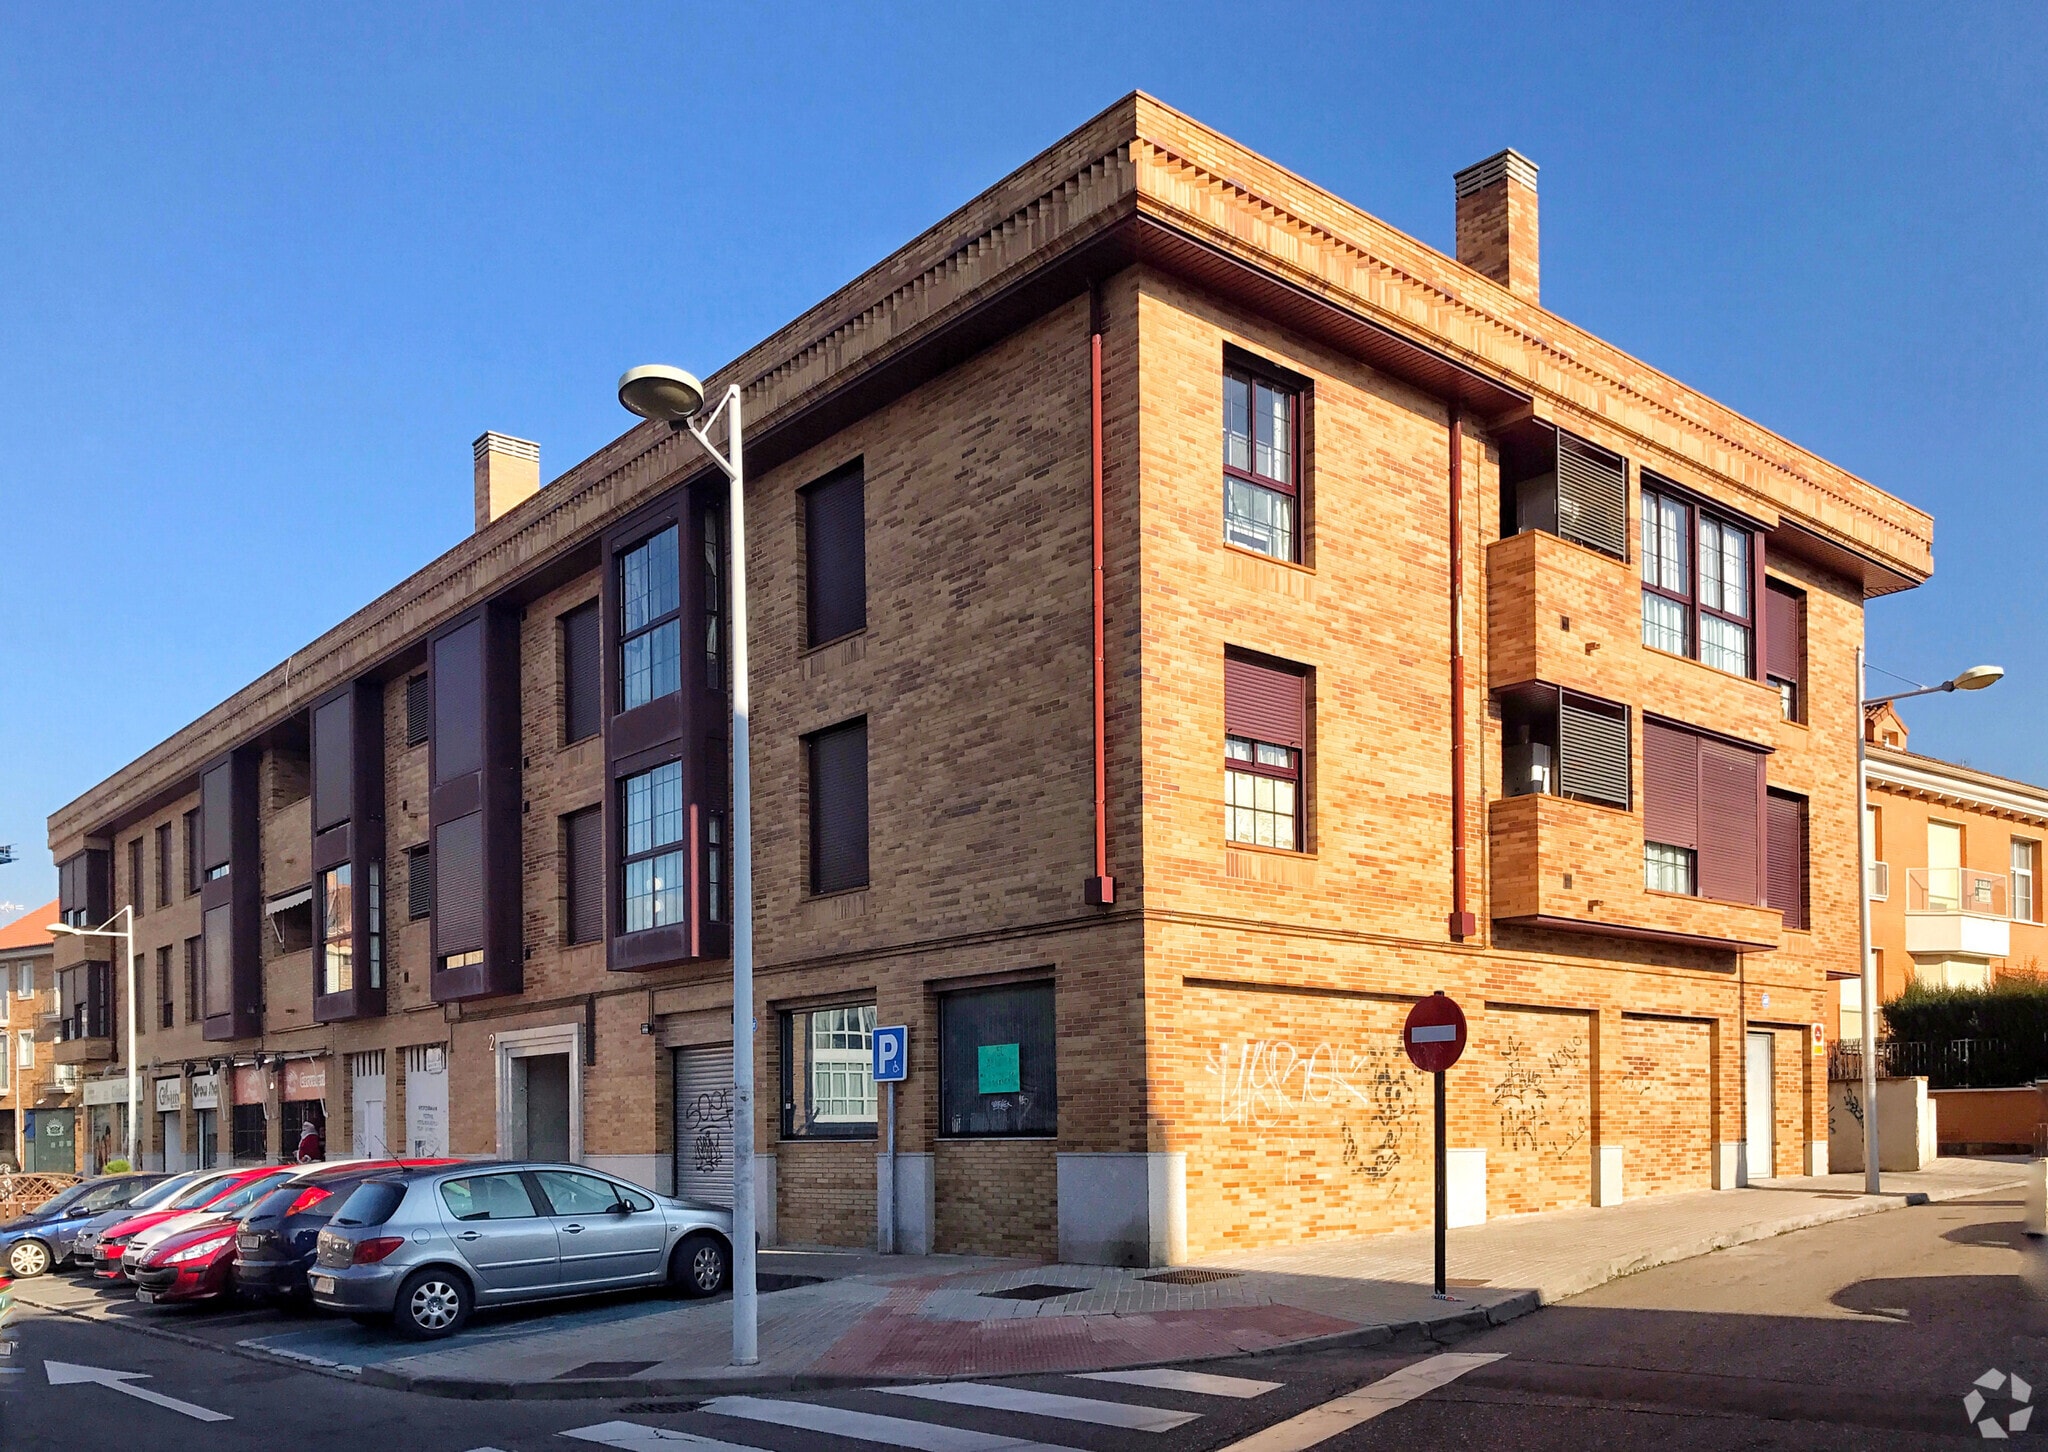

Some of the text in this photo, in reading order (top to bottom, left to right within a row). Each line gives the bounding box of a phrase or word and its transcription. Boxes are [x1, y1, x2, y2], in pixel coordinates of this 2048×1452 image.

[489, 1034, 495, 1051] 2
[879, 1033, 899, 1074] P
[193, 1082, 207, 1098] Grow
